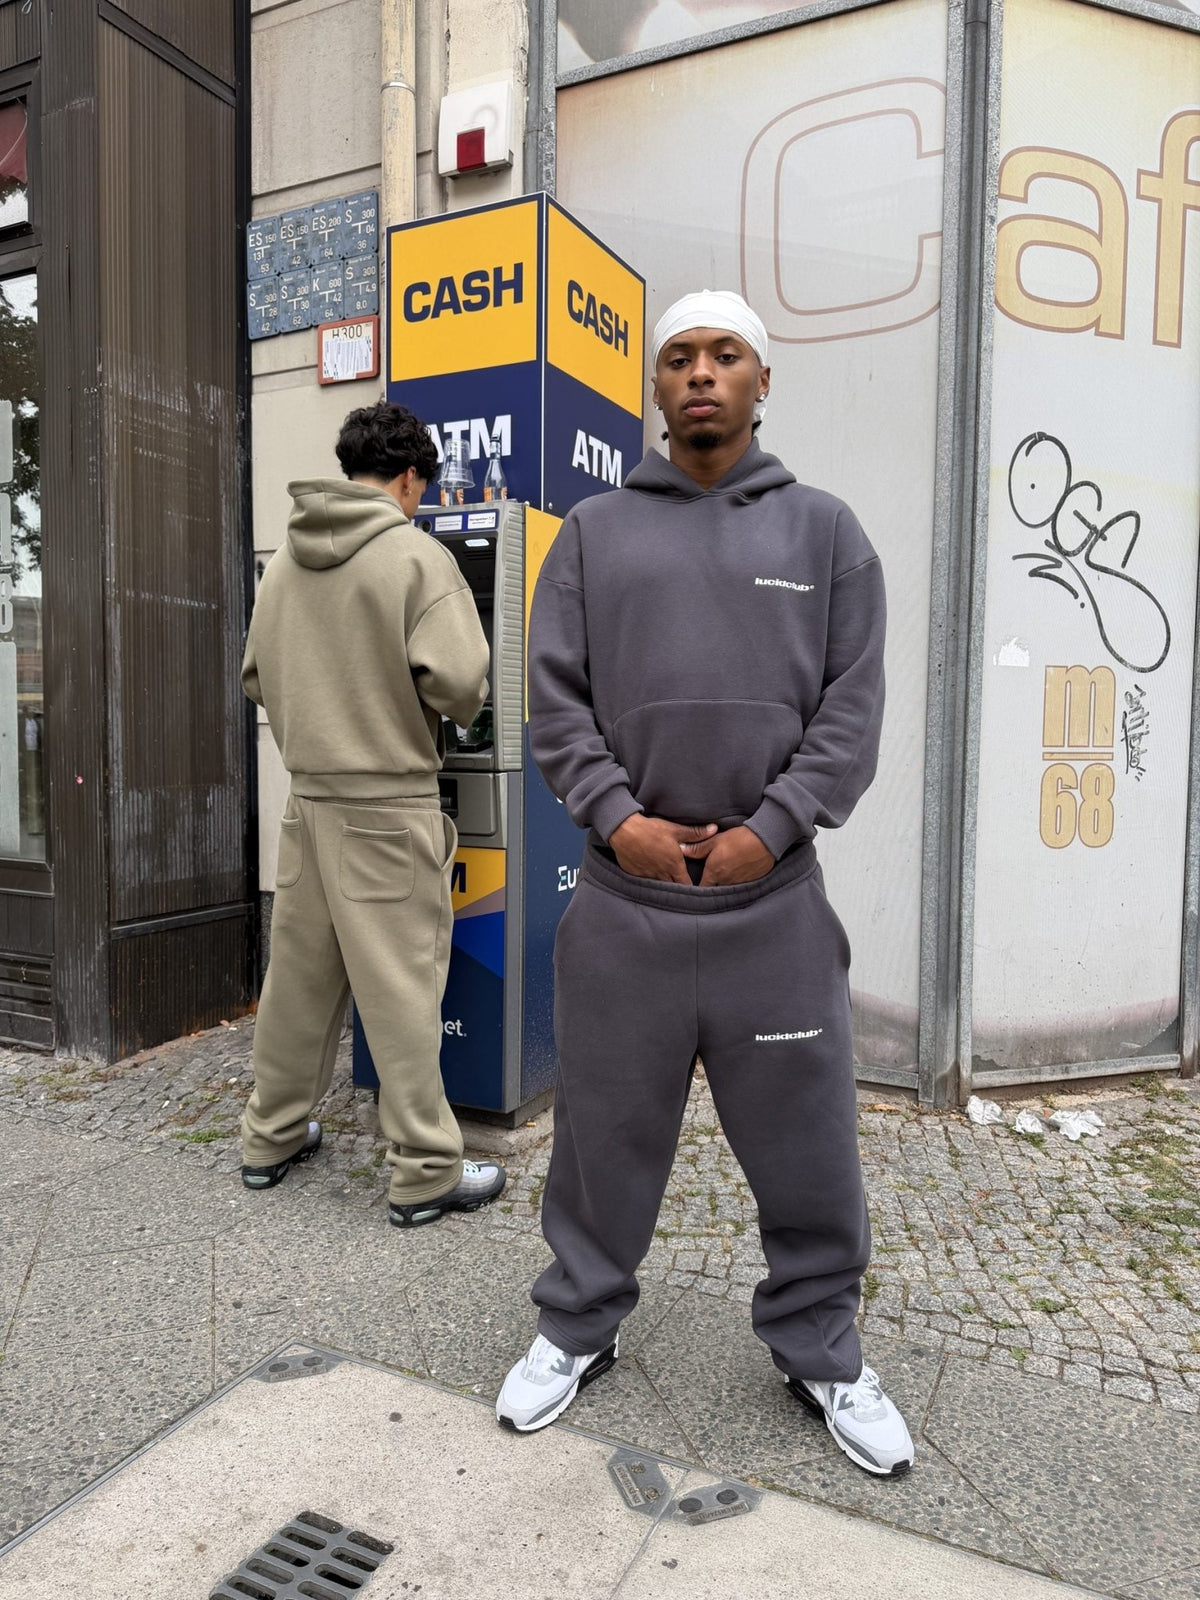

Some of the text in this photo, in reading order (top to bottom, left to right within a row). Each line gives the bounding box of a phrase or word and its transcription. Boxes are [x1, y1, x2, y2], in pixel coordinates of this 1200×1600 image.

[312, 215, 326, 231] ES
[328, 216, 342, 229] 200
[345, 208, 376, 224] S 300
[249, 232, 277, 247] ES 150
[280, 223, 295, 240] ES
[297, 224, 309, 236] 150
[345, 266, 354, 280] S
[362, 266, 376, 277] 300
[280, 285, 288, 300] S
[296, 285, 309, 297] 300
[312, 278, 321, 292] K
[403, 262, 523, 323] CASH
[249, 293, 277, 307] S 300
[567, 279, 628, 358] CASH
[572, 428, 623, 489] ATM
[1039, 762, 1115, 849] 68
